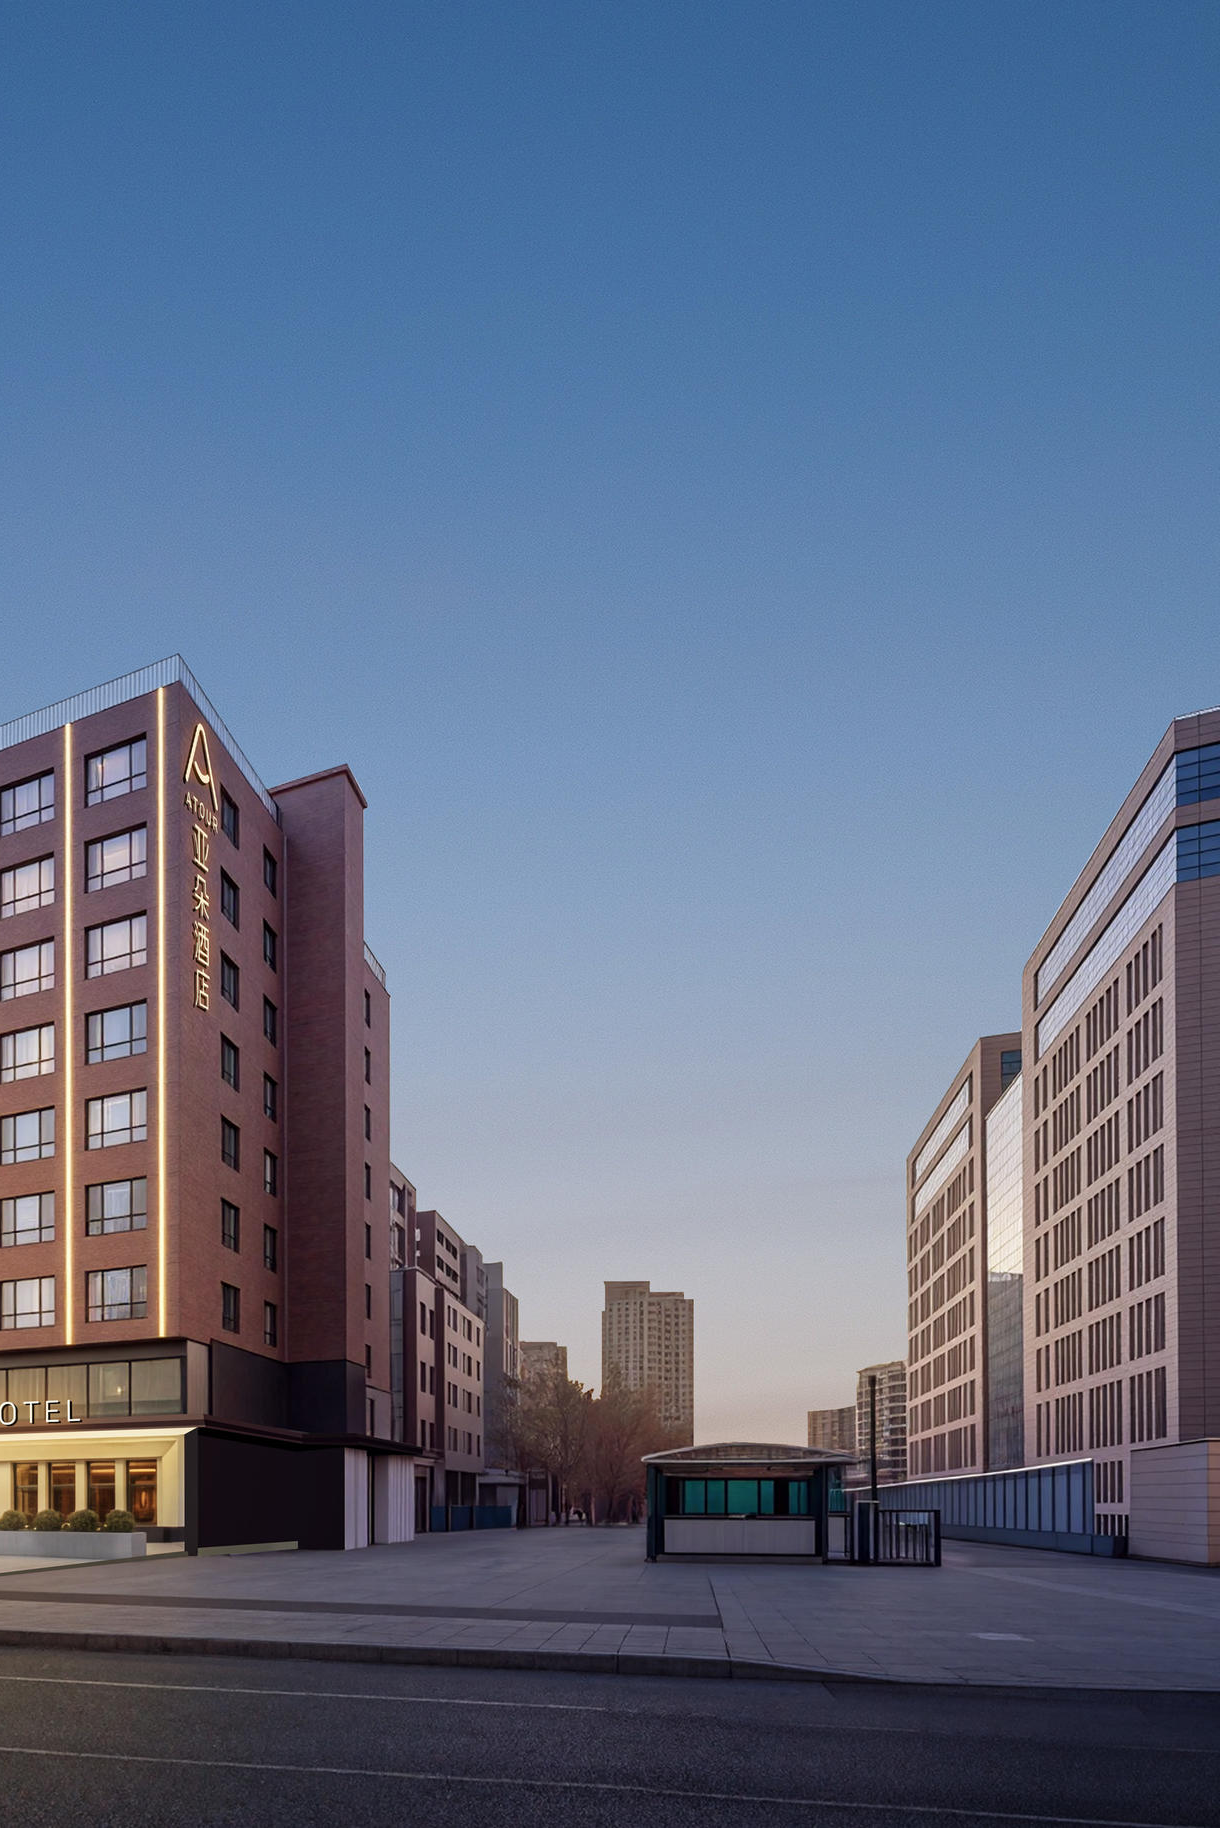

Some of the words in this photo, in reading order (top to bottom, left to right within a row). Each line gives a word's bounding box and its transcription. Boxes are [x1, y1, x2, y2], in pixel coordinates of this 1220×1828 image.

[185, 792, 219, 833] ATOUR
[192, 824, 210, 1012] 亚朵酒店
